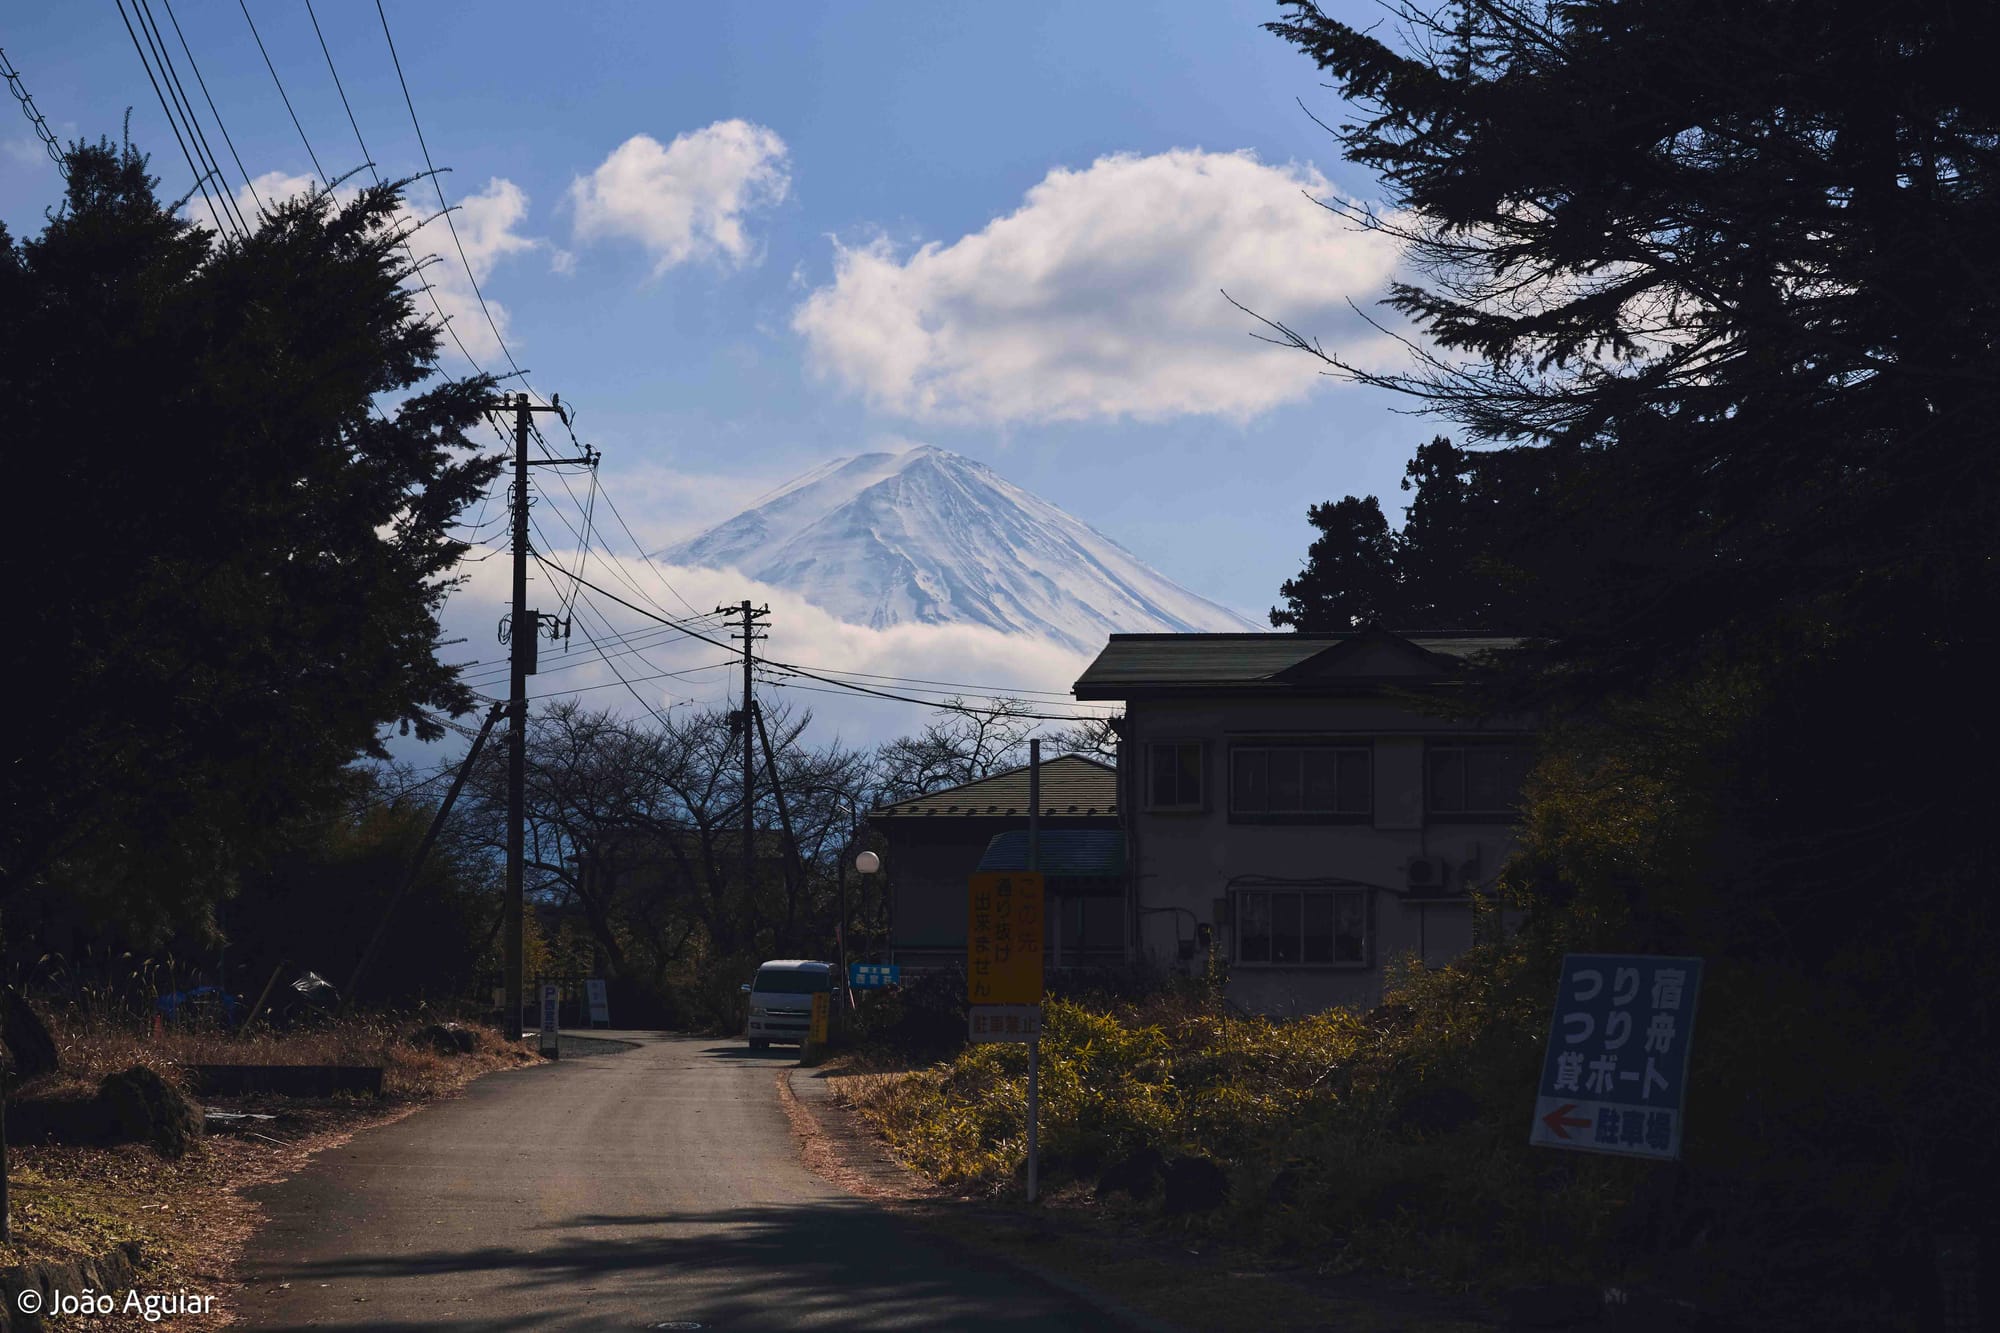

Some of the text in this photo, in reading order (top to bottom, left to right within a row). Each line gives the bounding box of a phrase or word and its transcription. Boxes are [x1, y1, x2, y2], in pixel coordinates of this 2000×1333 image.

[993, 878, 1012, 963] 通り抜け
[1018, 878, 1038, 953] この先
[973, 890, 992, 999] 出来ません
[1571, 966, 1687, 1010] つり宿
[1562, 1010, 1676, 1055] つり舟
[1553, 1050, 1670, 1099] 貸ボート
[1594, 1106, 1672, 1151] 駐車場
